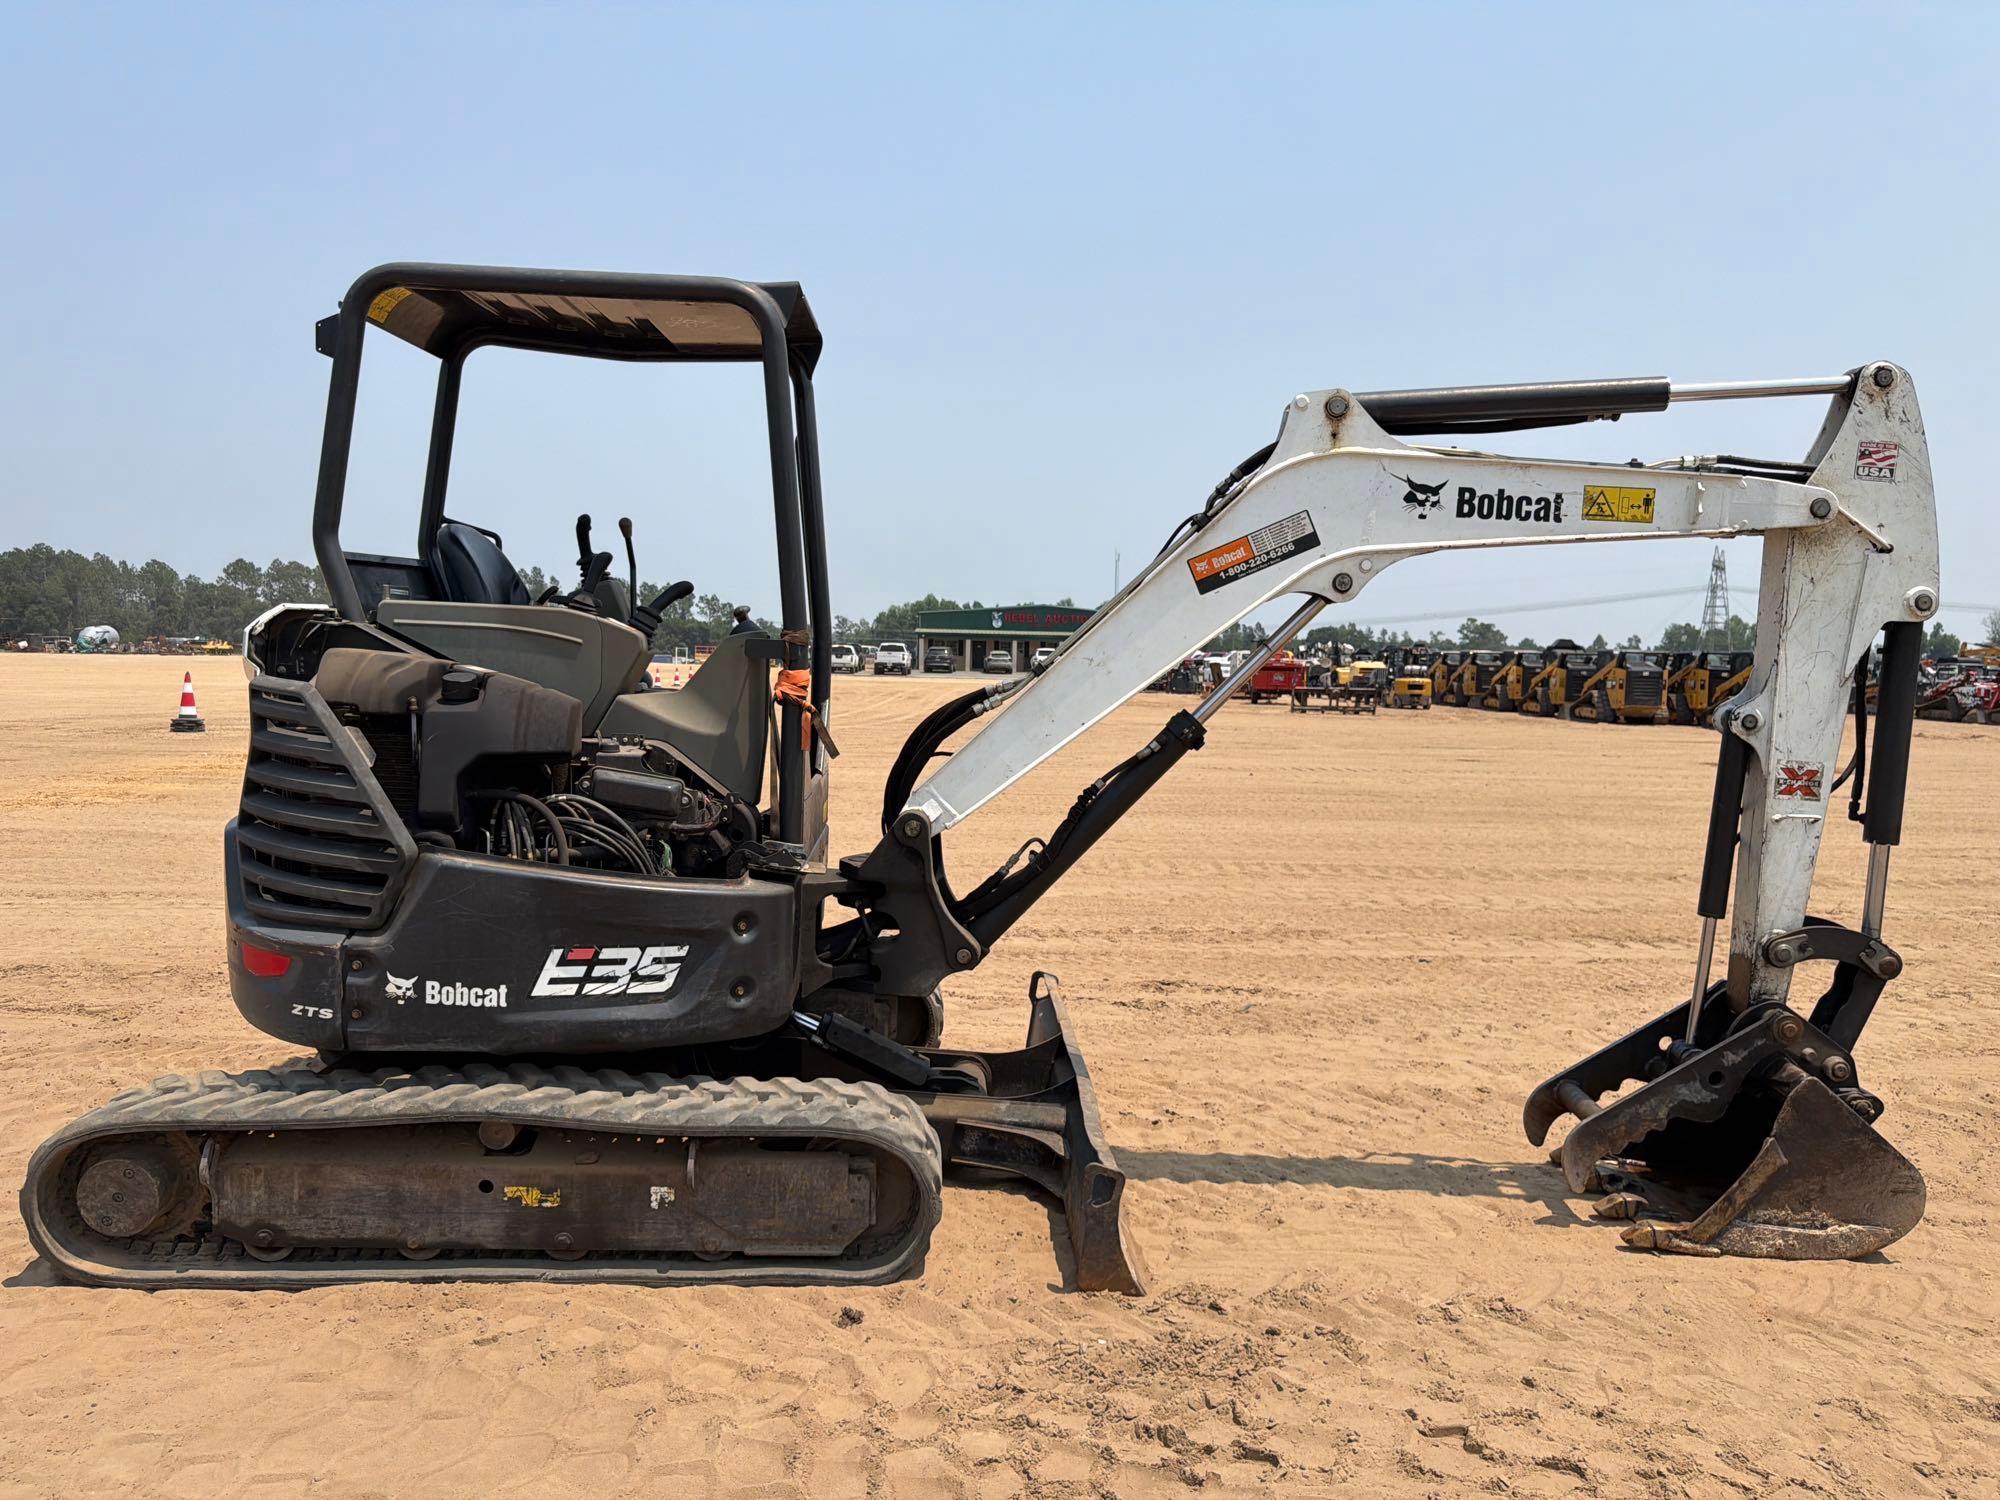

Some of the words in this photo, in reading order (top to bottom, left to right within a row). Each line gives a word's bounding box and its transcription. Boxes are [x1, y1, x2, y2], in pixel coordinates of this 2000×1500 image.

[1858, 466, 1890, 478] USA
[1456, 487, 1564, 523] Bobcat
[1212, 547, 1246, 568] Bobcat
[1219, 542, 1295, 580] 1-800-220-6266
[530, 945, 689, 998] E35
[425, 981, 508, 1008] Bobcat
[291, 1003, 334, 1020] ZTS
